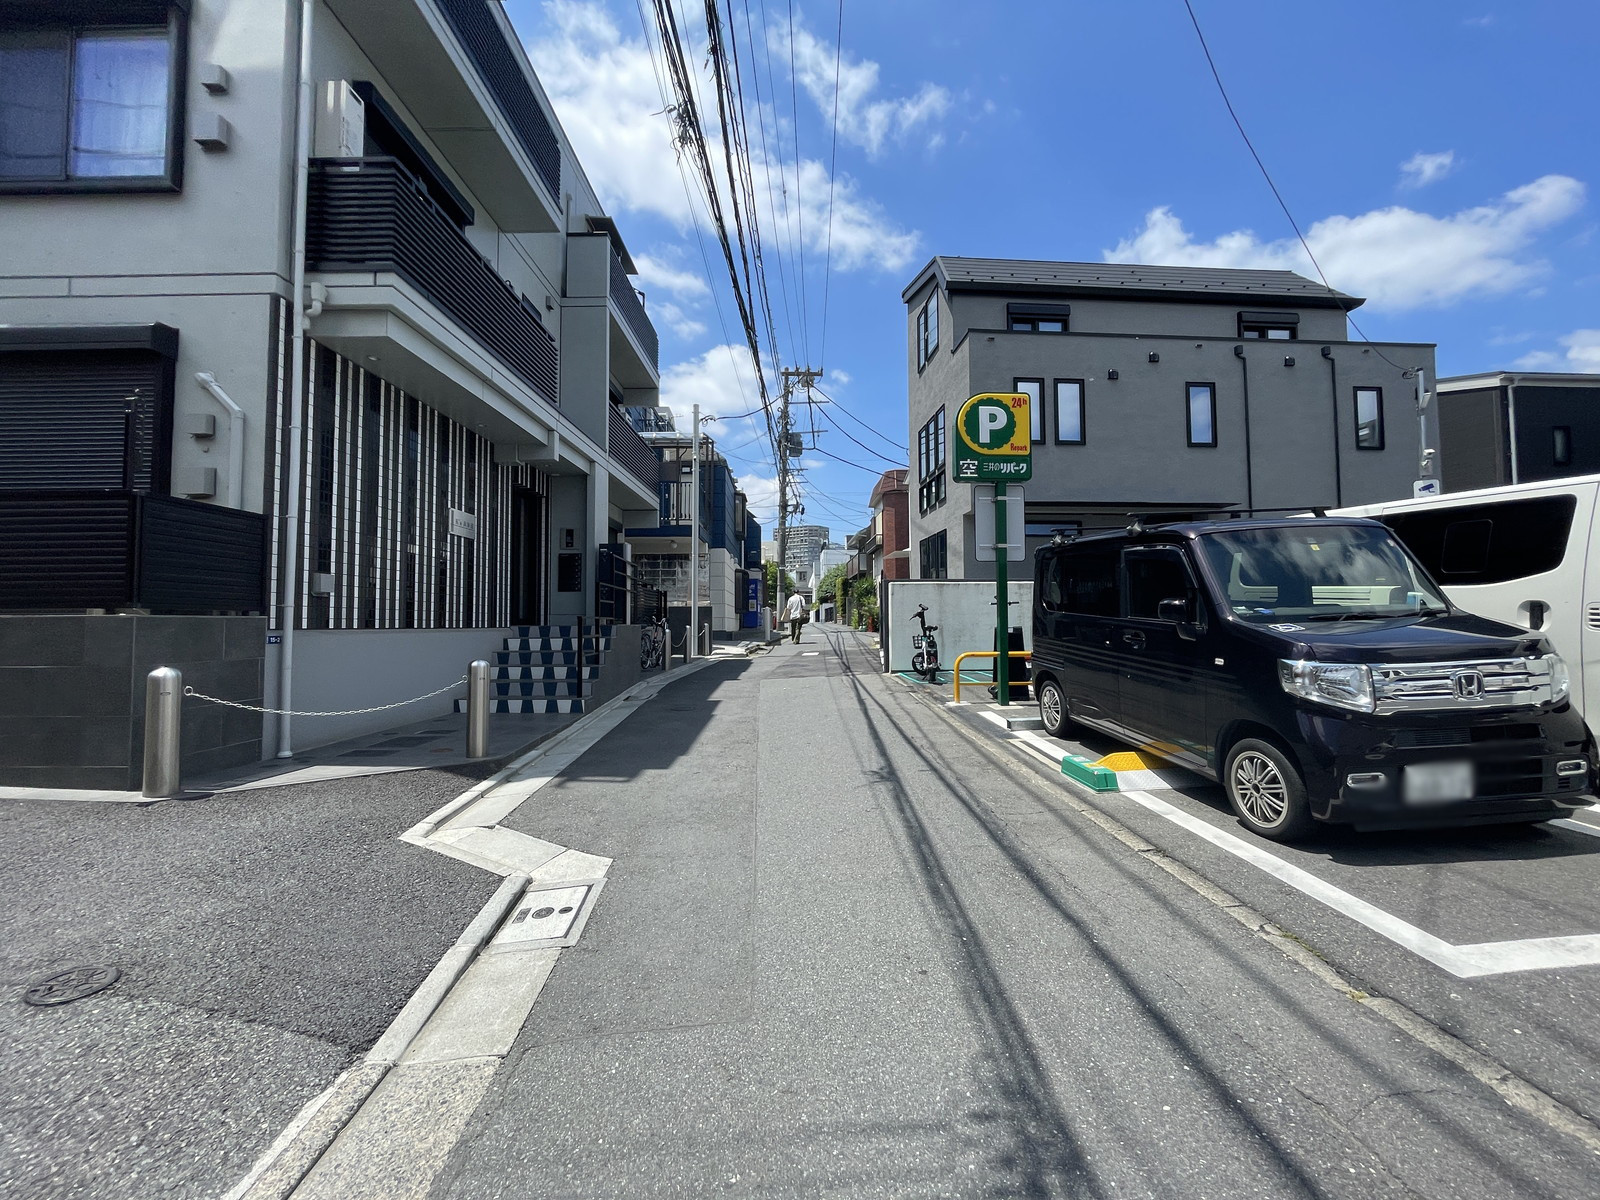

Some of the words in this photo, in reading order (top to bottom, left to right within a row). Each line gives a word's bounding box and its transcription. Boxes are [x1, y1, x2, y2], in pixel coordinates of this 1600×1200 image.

[978, 406, 1007, 443] P
[1010, 443, 1027, 452] Repark
[960, 459, 978, 477] 空
[983, 462, 1027, 474] 三井のリパーク
